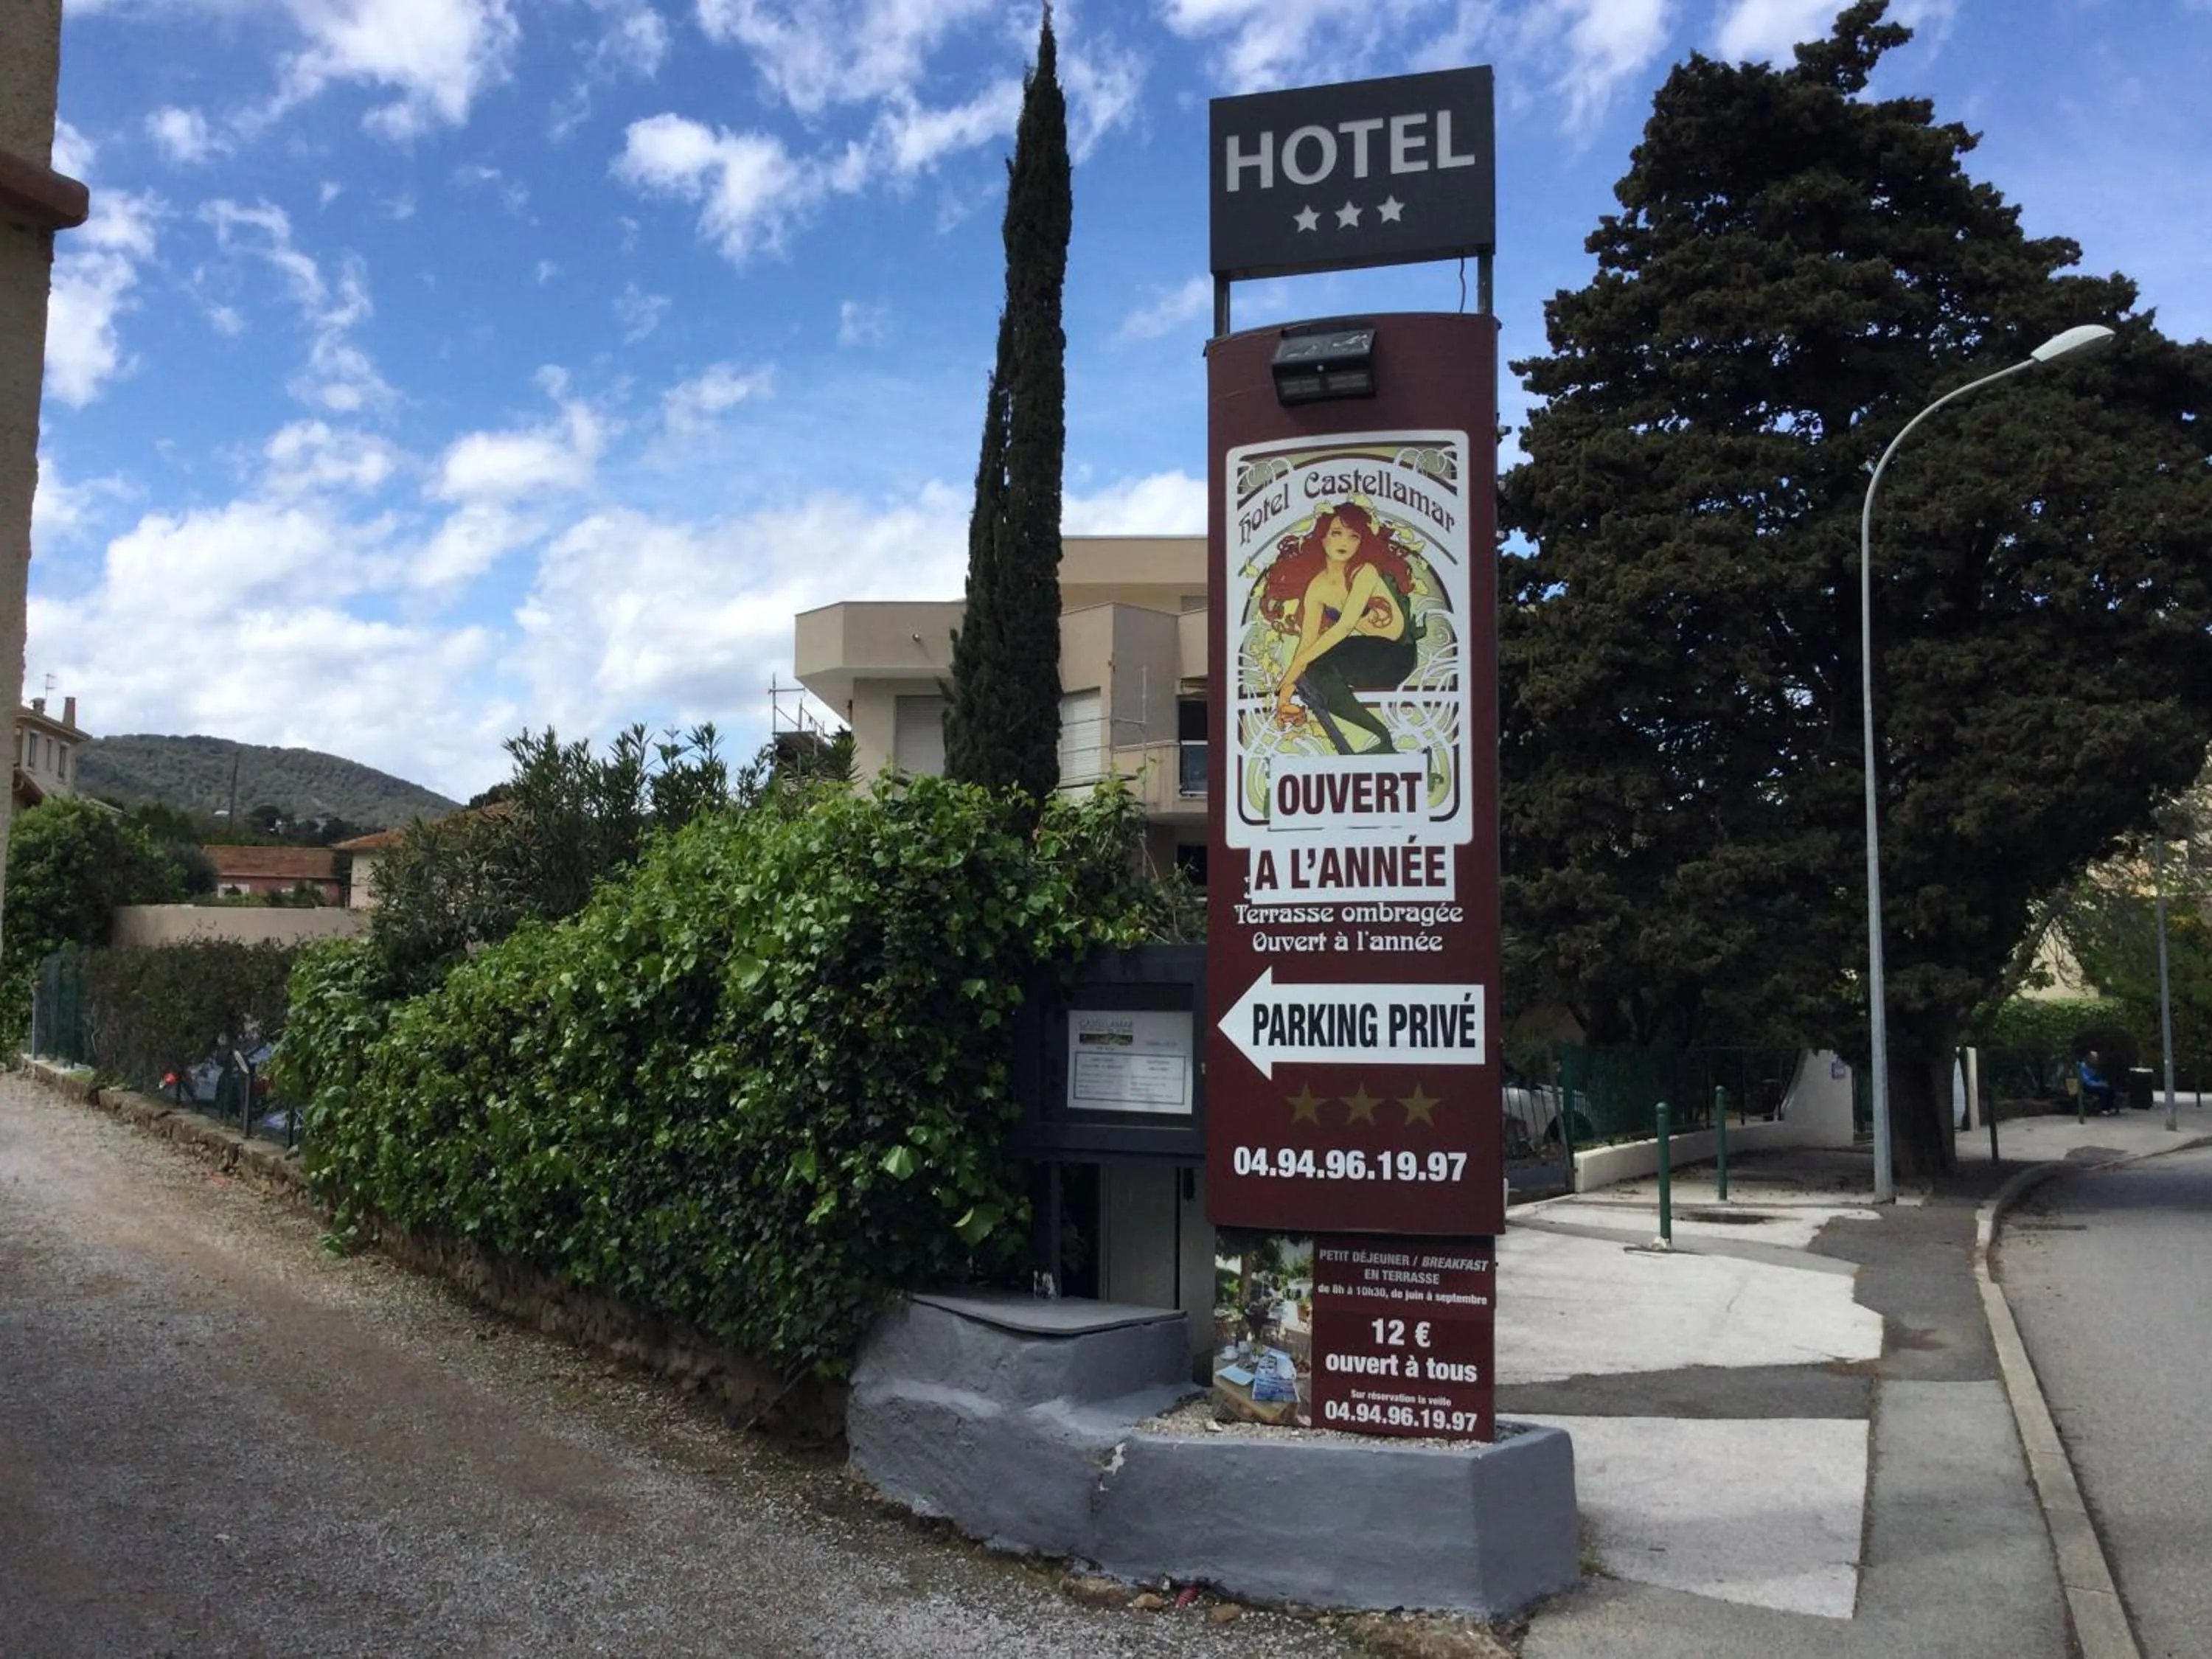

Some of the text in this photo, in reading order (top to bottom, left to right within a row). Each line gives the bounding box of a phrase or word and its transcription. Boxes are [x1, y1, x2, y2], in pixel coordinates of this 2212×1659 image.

[1226, 110, 1475, 192] HOTEL
[1304, 468, 1456, 534] Castellamar
[1277, 772, 1422, 815] OUVERT
[1254, 849, 1279, 890] A
[1291, 835, 1447, 889] L'ANNÉE
[1234, 902, 1464, 927] Terrasse ombragée
[1253, 931, 1444, 952] Ouvert à l'année
[1253, 992, 1476, 1048] PARKING PRIVÉ
[1234, 1147, 1467, 1182] 04.94.96.19.97
[1319, 1248, 1489, 1272] PETIT DÉJEUNER / BREAKFAST
[1363, 1268, 1440, 1285] EN TERRASSE
[1318, 1283, 1331, 1294] de
[1357, 1286, 1389, 1300] 10h30,
[1391, 1288, 1404, 1298] de
[1405, 1289, 1425, 1301] juin
[1435, 1292, 1488, 1306] septembre
[1371, 1318, 1432, 1348] 12 €
[1326, 1353, 1478, 1382] ouvert à tous
[1350, 1389, 1366, 1399] Sur
[1368, 1391, 1416, 1403] réservation
[1324, 1400, 1478, 1433] 04.94.96.19.97
